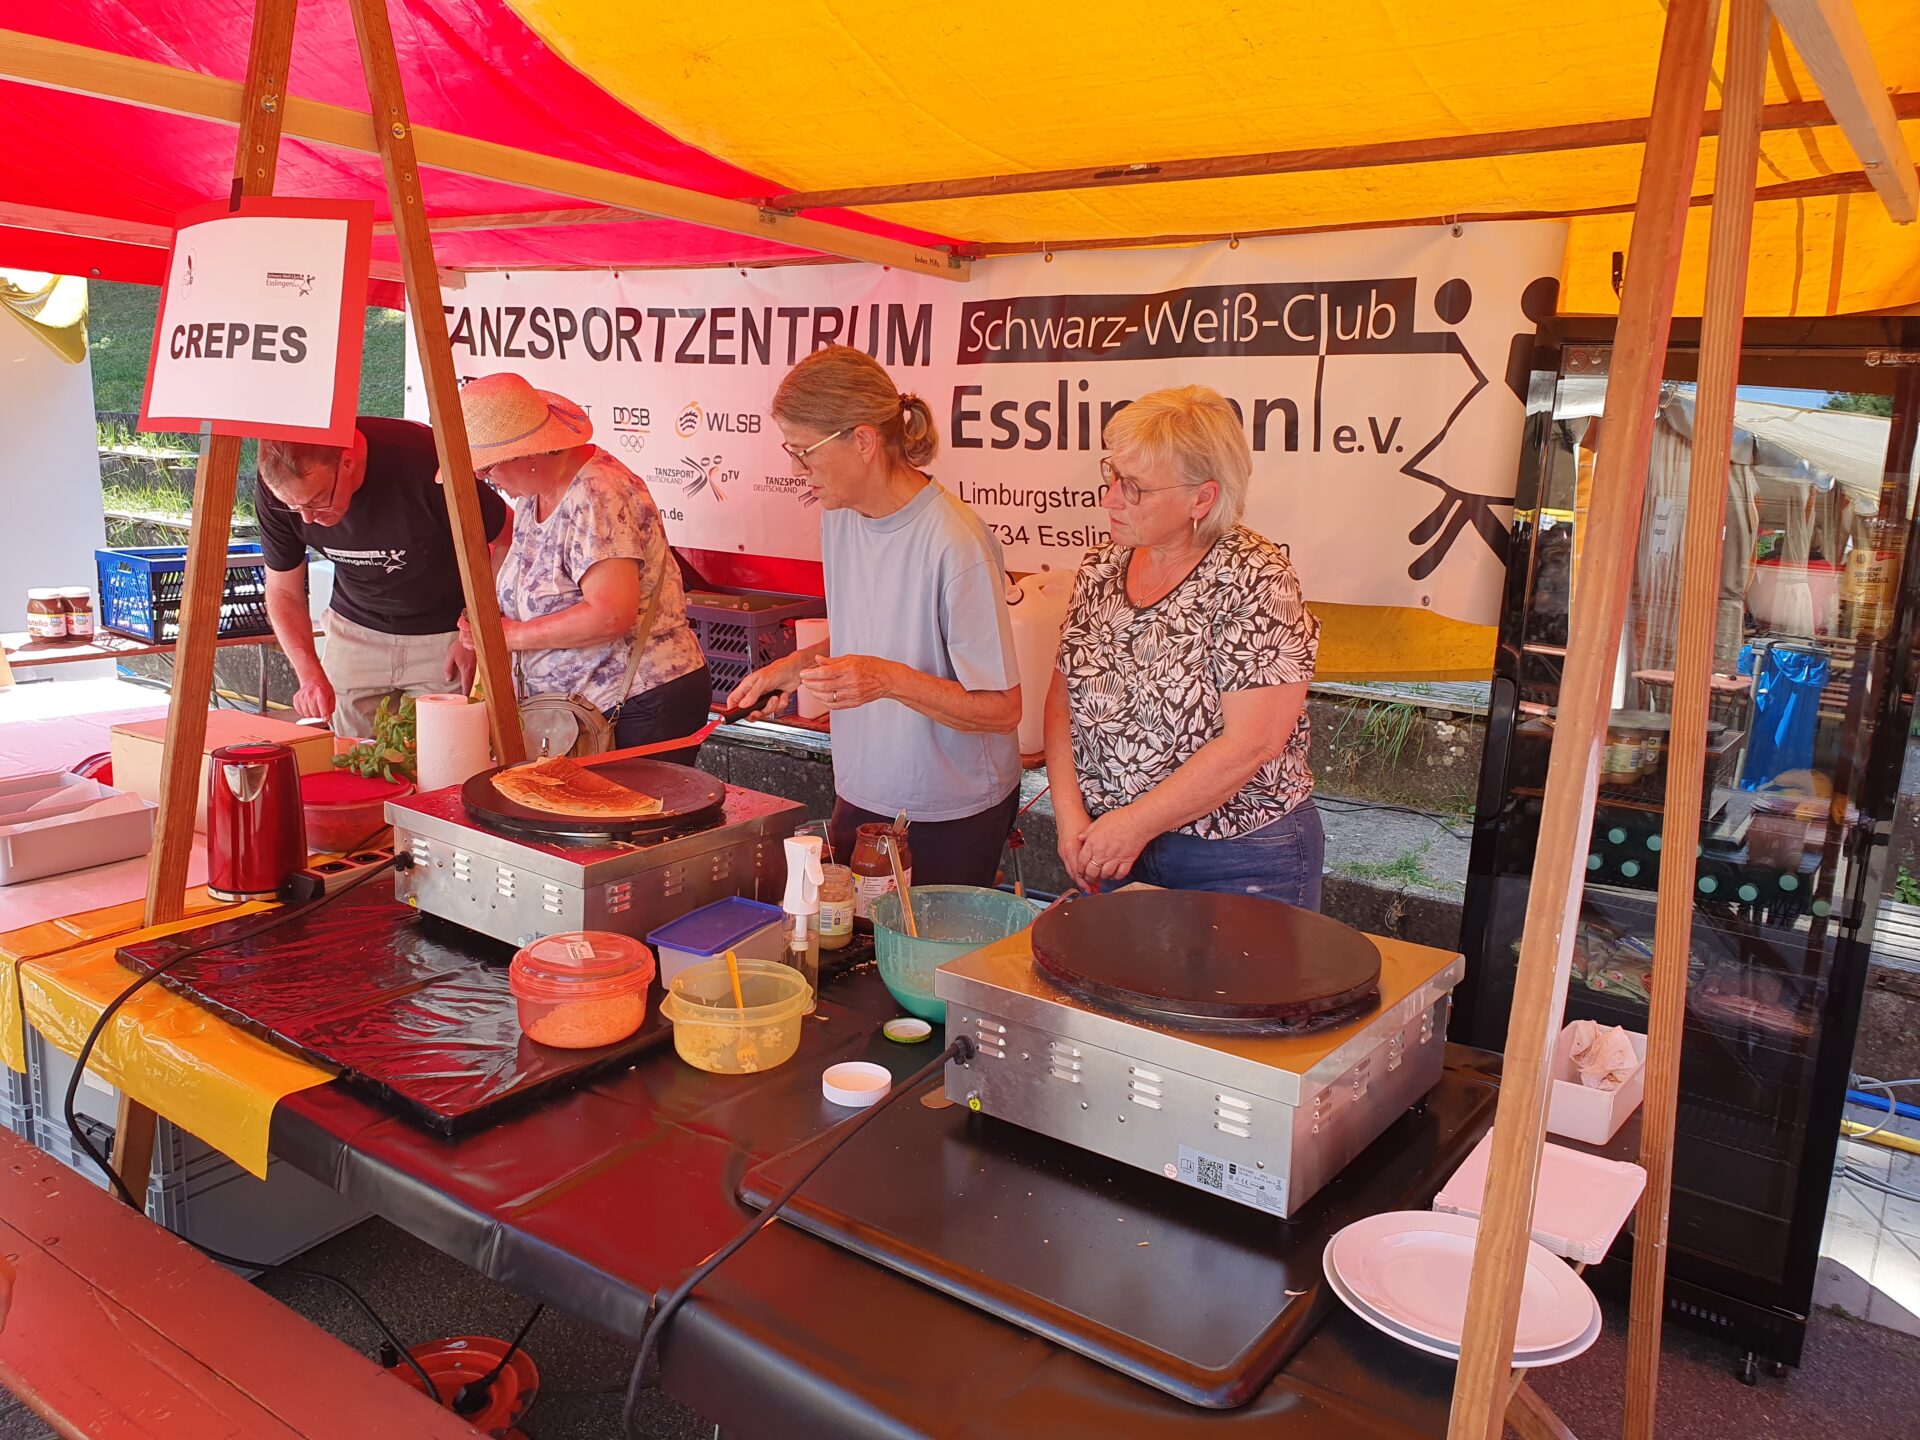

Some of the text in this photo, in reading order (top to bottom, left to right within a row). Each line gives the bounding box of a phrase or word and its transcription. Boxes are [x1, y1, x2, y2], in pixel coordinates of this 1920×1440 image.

[967, 289, 1396, 355] Schwarz-Weiß-Club
[170, 322, 308, 363] CREPES
[613, 406, 650, 426] DOSB
[706, 412, 761, 434] WLSB
[950, 379, 1404, 453] Esslin e.V.
[646, 475, 683, 485] DEUTSCHLAND
[655, 467, 695, 479] TANZSPORT
[721, 470, 740, 483] DTV
[765, 476, 808, 487] TANZSPOR
[753, 484, 798, 494] DEUTSCHLAND
[959, 481, 1110, 514] Limburgstra
